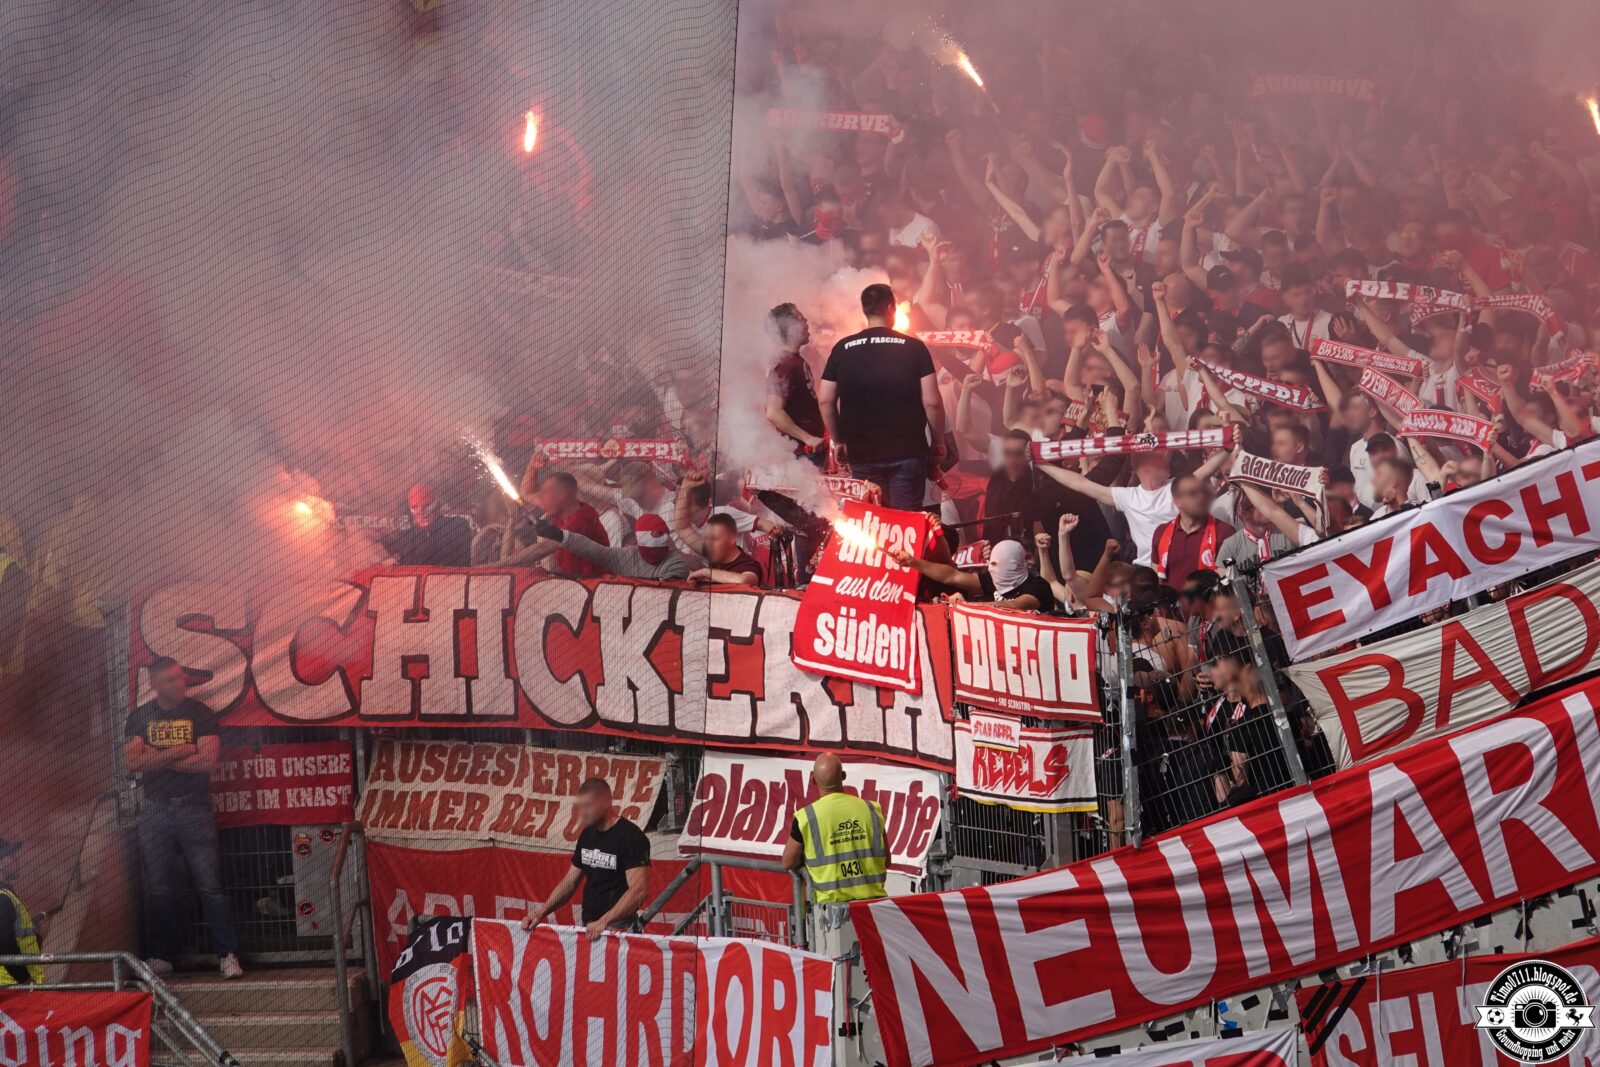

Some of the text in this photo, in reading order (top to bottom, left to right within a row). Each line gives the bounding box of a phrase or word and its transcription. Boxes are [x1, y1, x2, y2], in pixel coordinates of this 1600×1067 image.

[844, 336, 906, 349] FIGHT FASCISM
[1317, 341, 1355, 361] BAYERN
[1040, 427, 1225, 461] COLE GIO
[1240, 453, 1312, 489] alarMstufe
[836, 572, 904, 604] aus dem
[813, 606, 906, 671] süden
[953, 611, 1093, 705] COLEGIO
[1316, 582, 1600, 762] BAD
[243, 754, 277, 779] FÜR
[282, 753, 350, 777] UNSERE
[972, 743, 1071, 797] REBELS
[256, 787, 280, 810] IM
[286, 784, 352, 809] KNAST
[360, 789, 490, 832] IMMER
[490, 793, 560, 838] BEI
[687, 764, 941, 859] alarMtufe
[838, 820, 860, 830] SDS
[474, 920, 833, 1067] ROHRDORF
